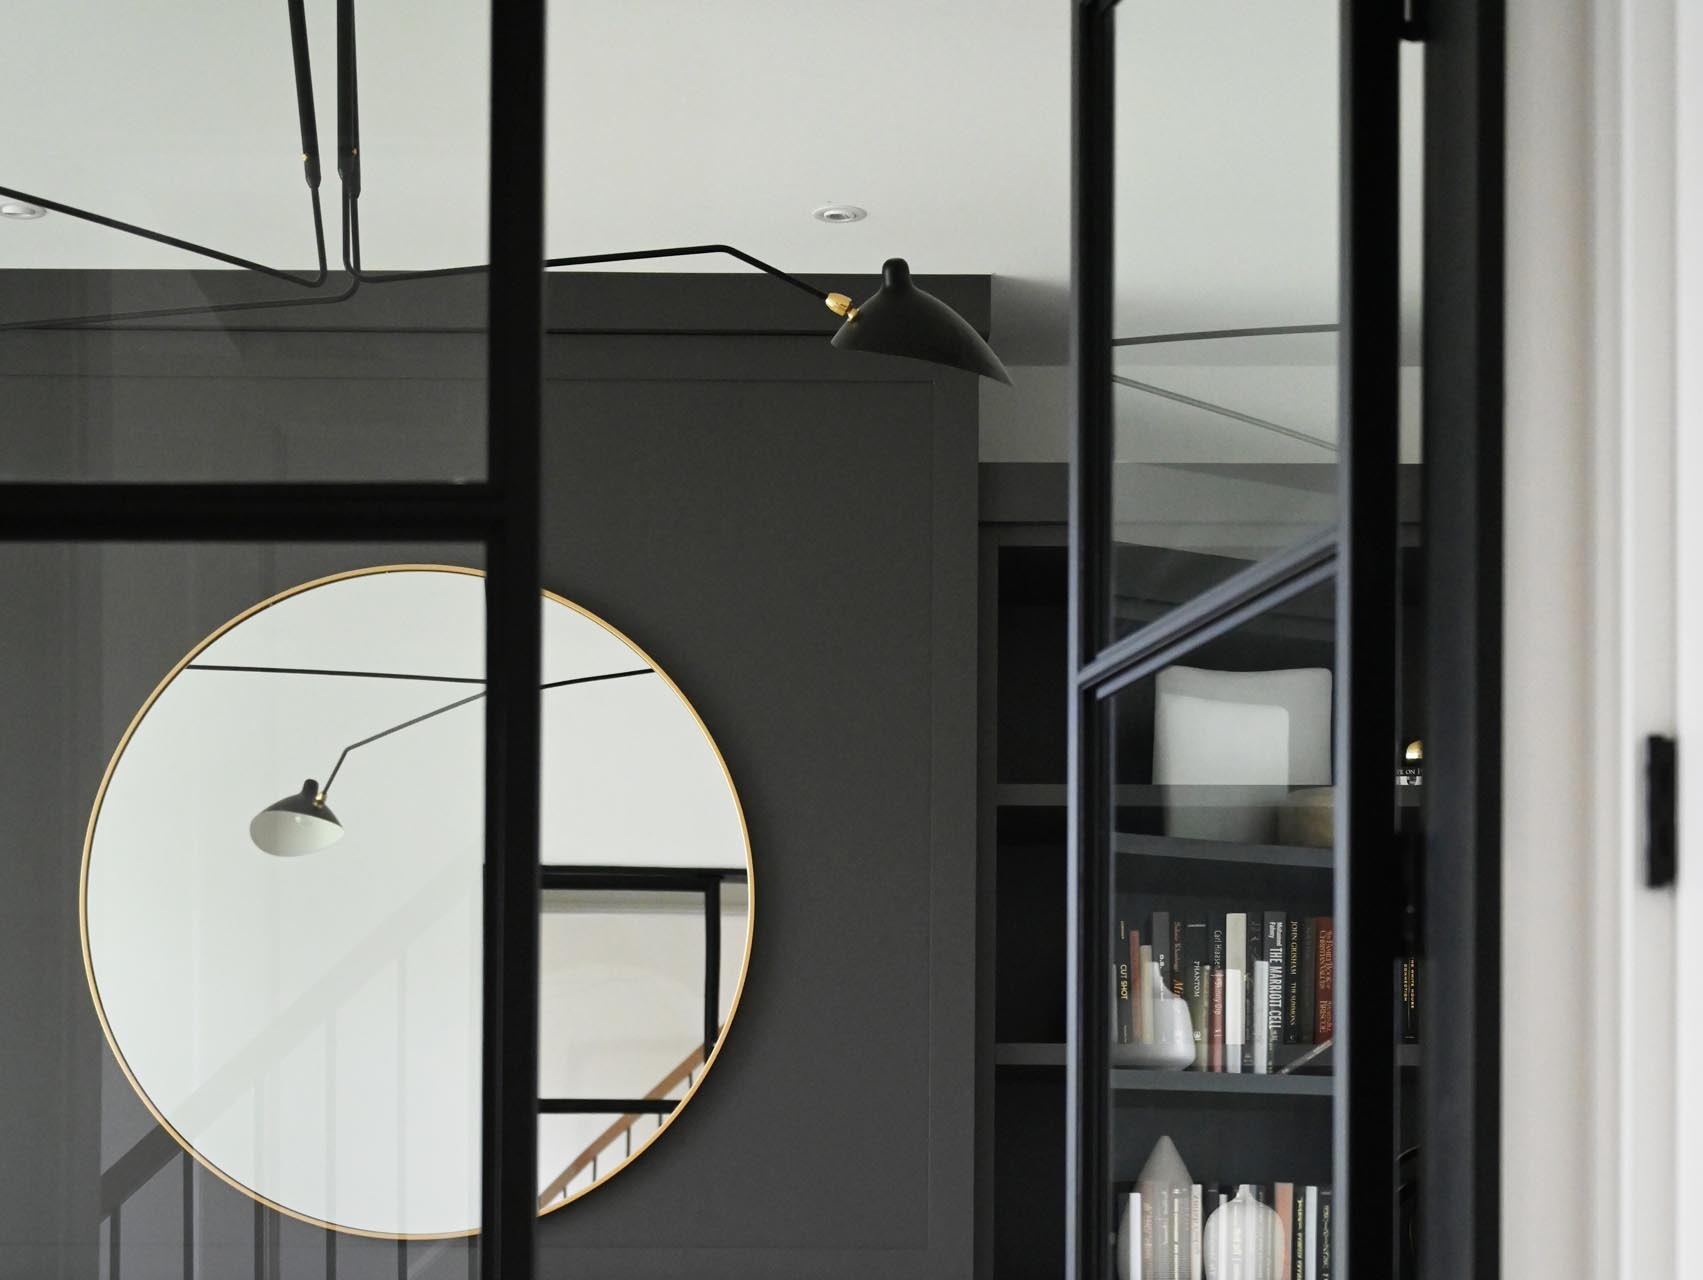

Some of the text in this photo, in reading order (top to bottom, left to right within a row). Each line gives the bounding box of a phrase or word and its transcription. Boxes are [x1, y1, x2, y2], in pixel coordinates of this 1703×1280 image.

[1214, 930, 1223, 944] Carl
[1290, 920, 1299, 942] JOHN
[1269, 948, 1283, 963] THE
[1290, 943, 1298, 975] GRISHAM
[1119, 964, 1129, 1000] CUT SHOT
[1193, 961, 1202, 998] PHANTOM
[1269, 966, 1283, 1008] MARRIOTT
[1268, 1010, 1283, 1030] CELL
